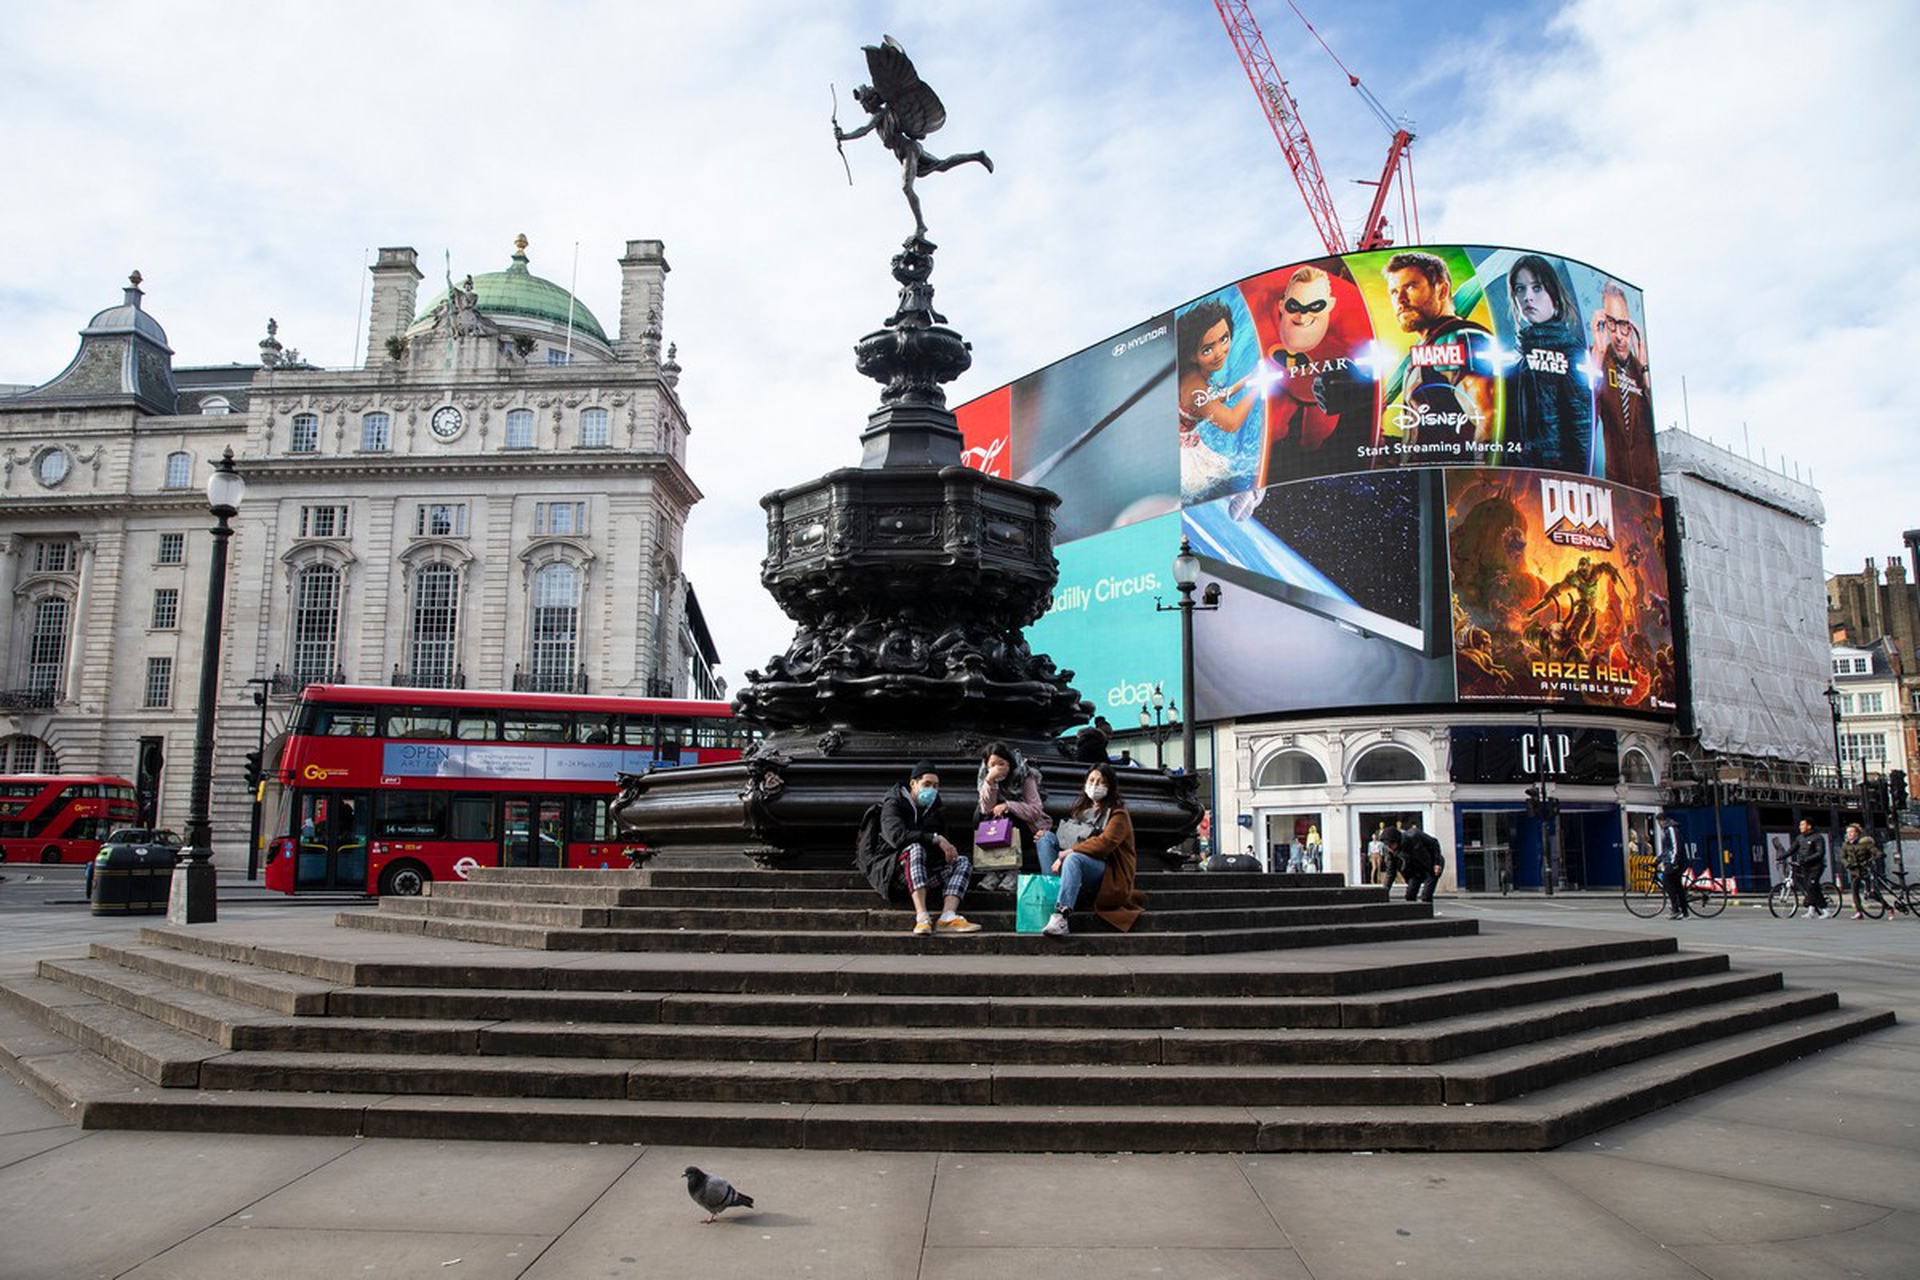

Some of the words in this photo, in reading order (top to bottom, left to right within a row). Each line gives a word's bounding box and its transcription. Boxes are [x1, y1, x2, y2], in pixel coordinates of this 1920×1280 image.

[1127, 325, 1167, 350] HYUNDAI
[1411, 345, 1465, 366] MARVEL
[1526, 348, 1565, 362] STAR
[1289, 358, 1349, 378] PIXAR
[1527, 357, 1568, 375] WARS
[1357, 444, 1390, 457] Start
[1394, 441, 1461, 454] Streaming
[1466, 440, 1503, 452] March
[1507, 441, 1523, 453] 24
[1540, 478, 1616, 542] DOOM
[1553, 531, 1610, 549] ETERNAL
[1095, 572, 1162, 601] Circus.
[1532, 661, 1591, 680] RAZE
[1596, 664, 1638, 685] HELL
[1540, 681, 1609, 694] AVAILABLE
[1613, 686, 1633, 696] NOW
[403, 745, 450, 760] OPEN
[1521, 733, 1570, 774] GAP
